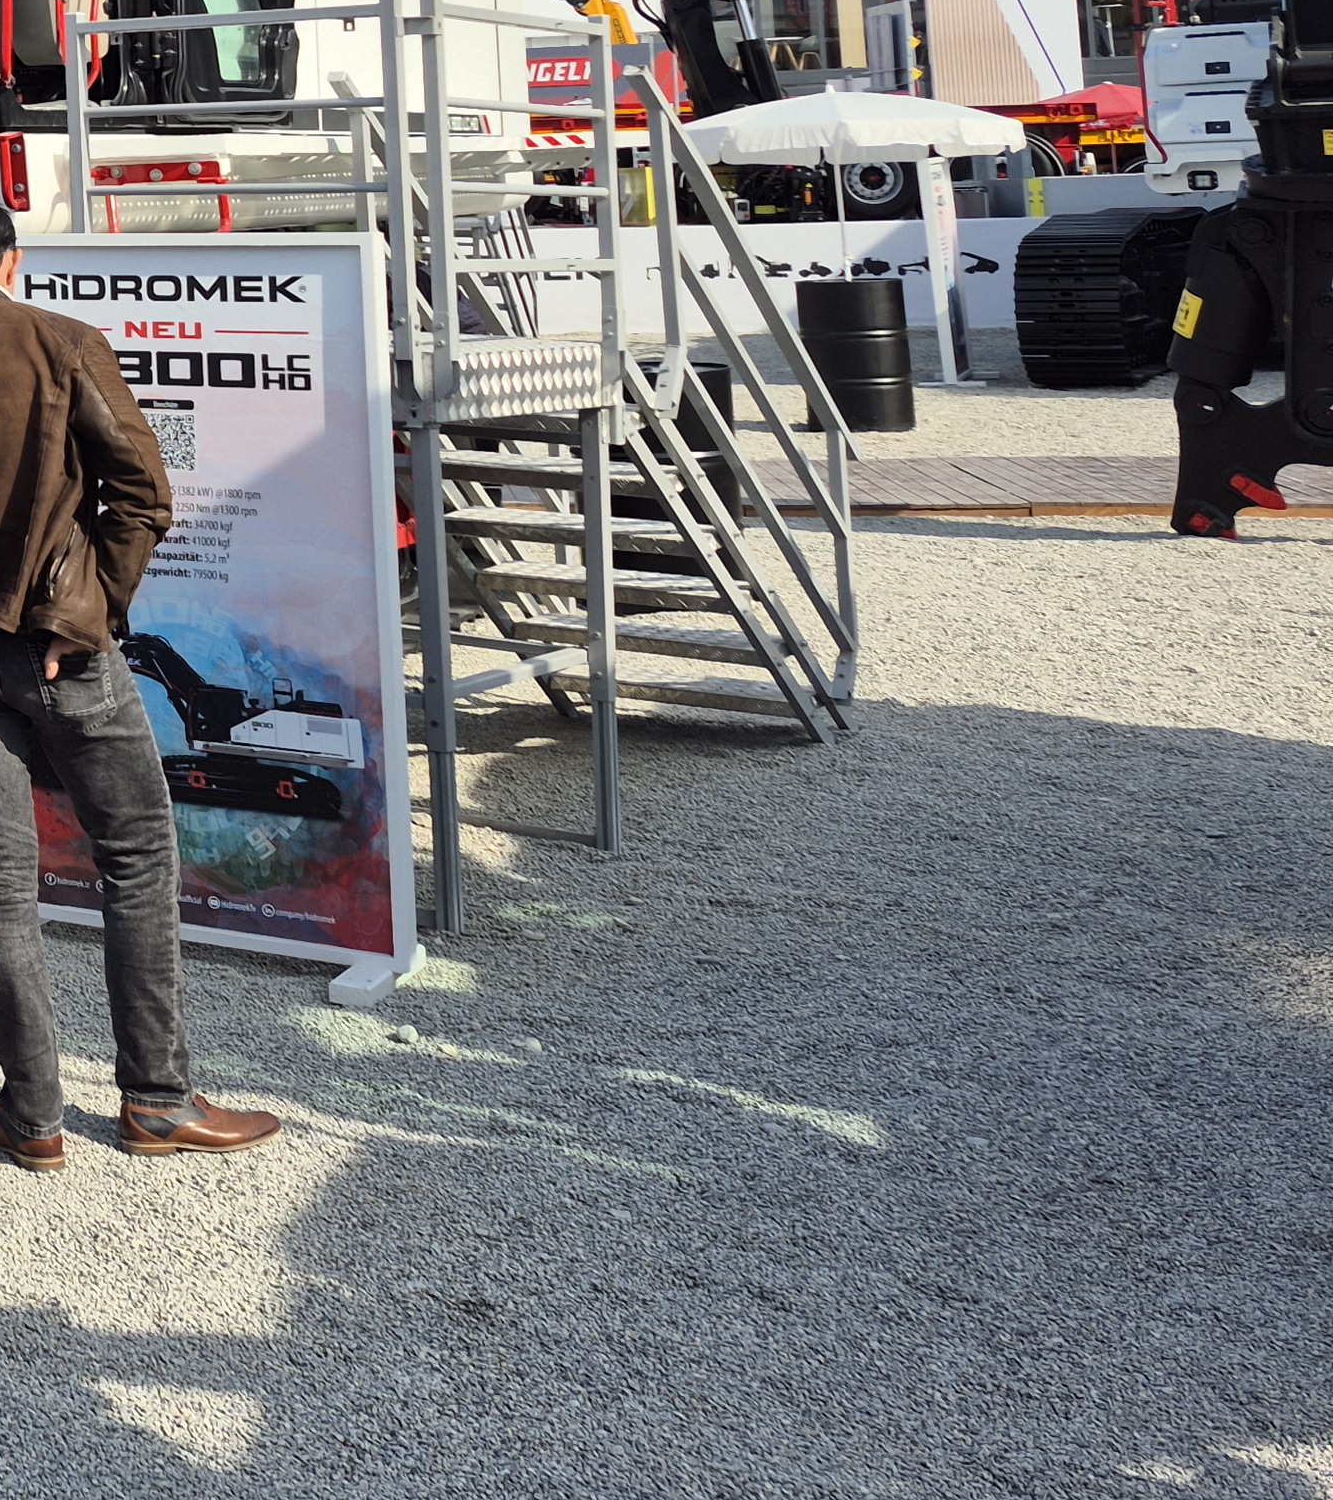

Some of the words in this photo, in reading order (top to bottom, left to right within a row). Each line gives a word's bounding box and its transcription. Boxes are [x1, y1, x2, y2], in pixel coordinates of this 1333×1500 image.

[124, 321, 202, 339] NEU
[215, 488, 243, 499] @1800
[244, 491, 262, 501] rpm
[175, 501, 195, 513] 2250
[196, 503, 211, 513] Nm
[212, 504, 240, 516] @1300
[240, 507, 258, 518] rpm
[194, 519, 219, 531] 34700
[151, 549, 203, 562] lkapazität:
[218, 570, 229, 583] kg
